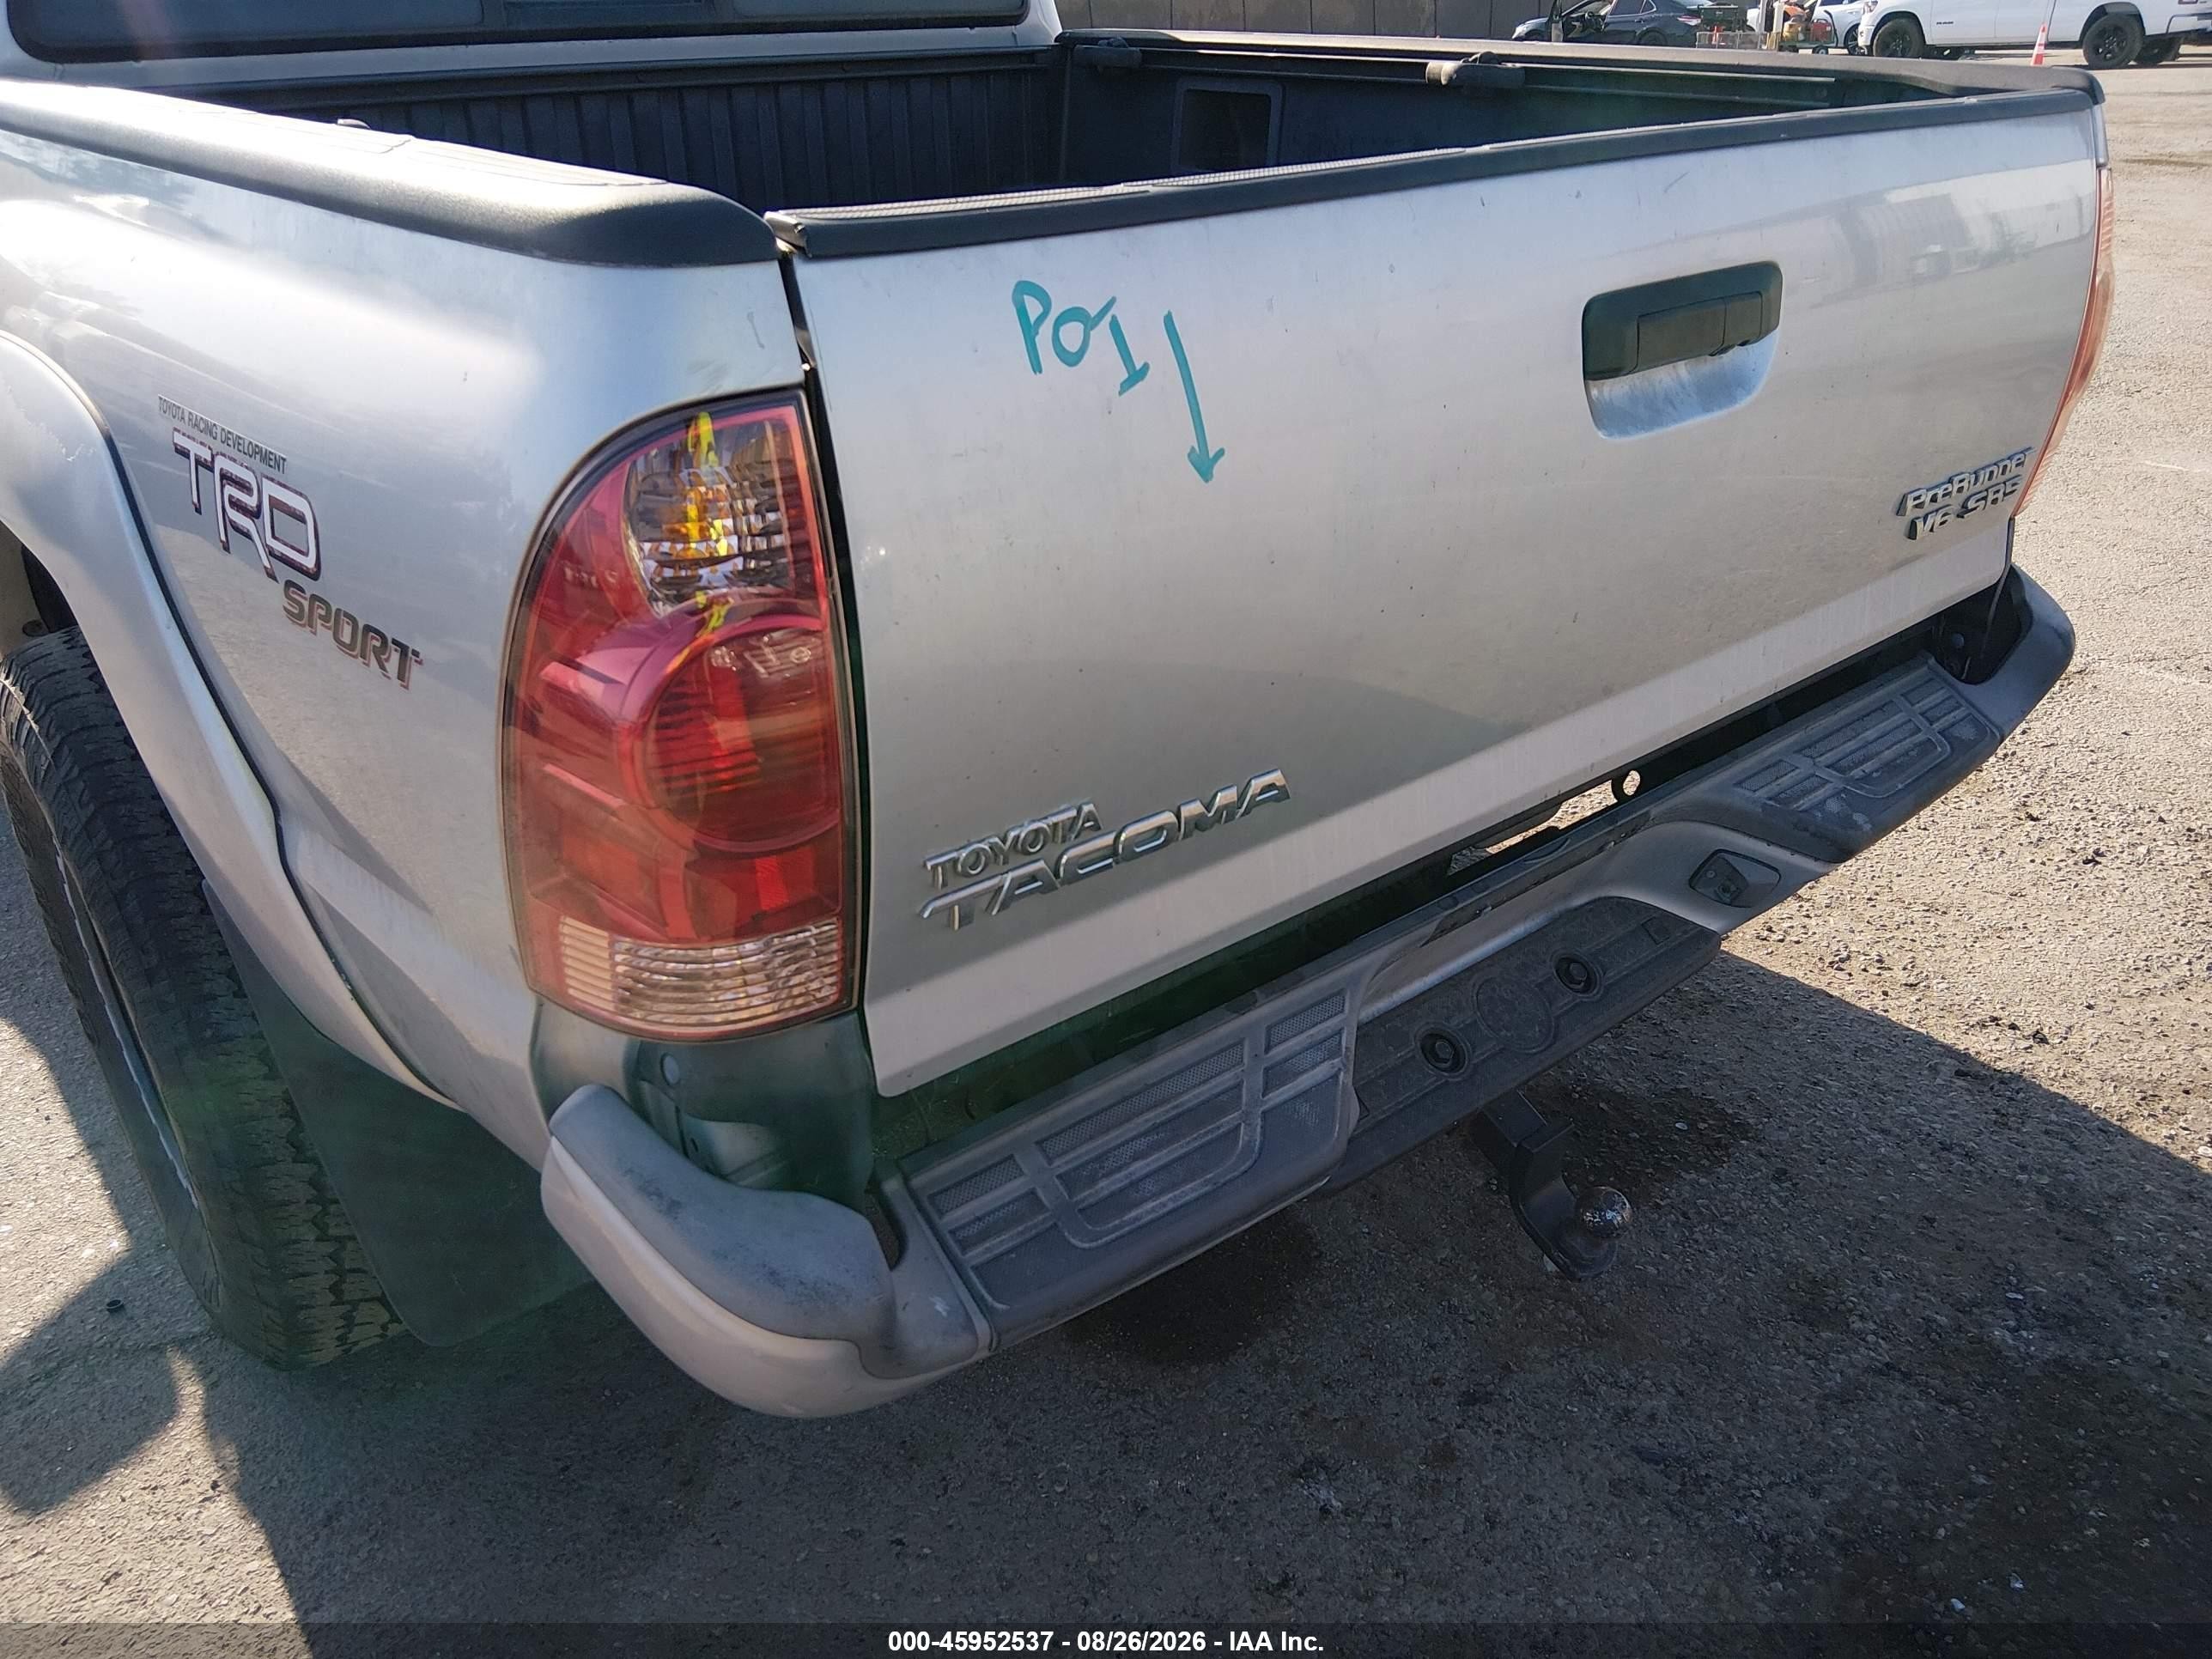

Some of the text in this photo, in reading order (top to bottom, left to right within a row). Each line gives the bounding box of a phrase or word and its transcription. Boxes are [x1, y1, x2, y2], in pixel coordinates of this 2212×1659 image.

[158, 396, 288, 475] TOYOTA RACING DEVELOPMENT
[173, 427, 322, 583] TRD
[1906, 504, 1954, 541] V6
[283, 580, 423, 690] SPORT
[918, 768, 1291, 932] TACOMA
[923, 802, 1103, 890] TOYOTA
